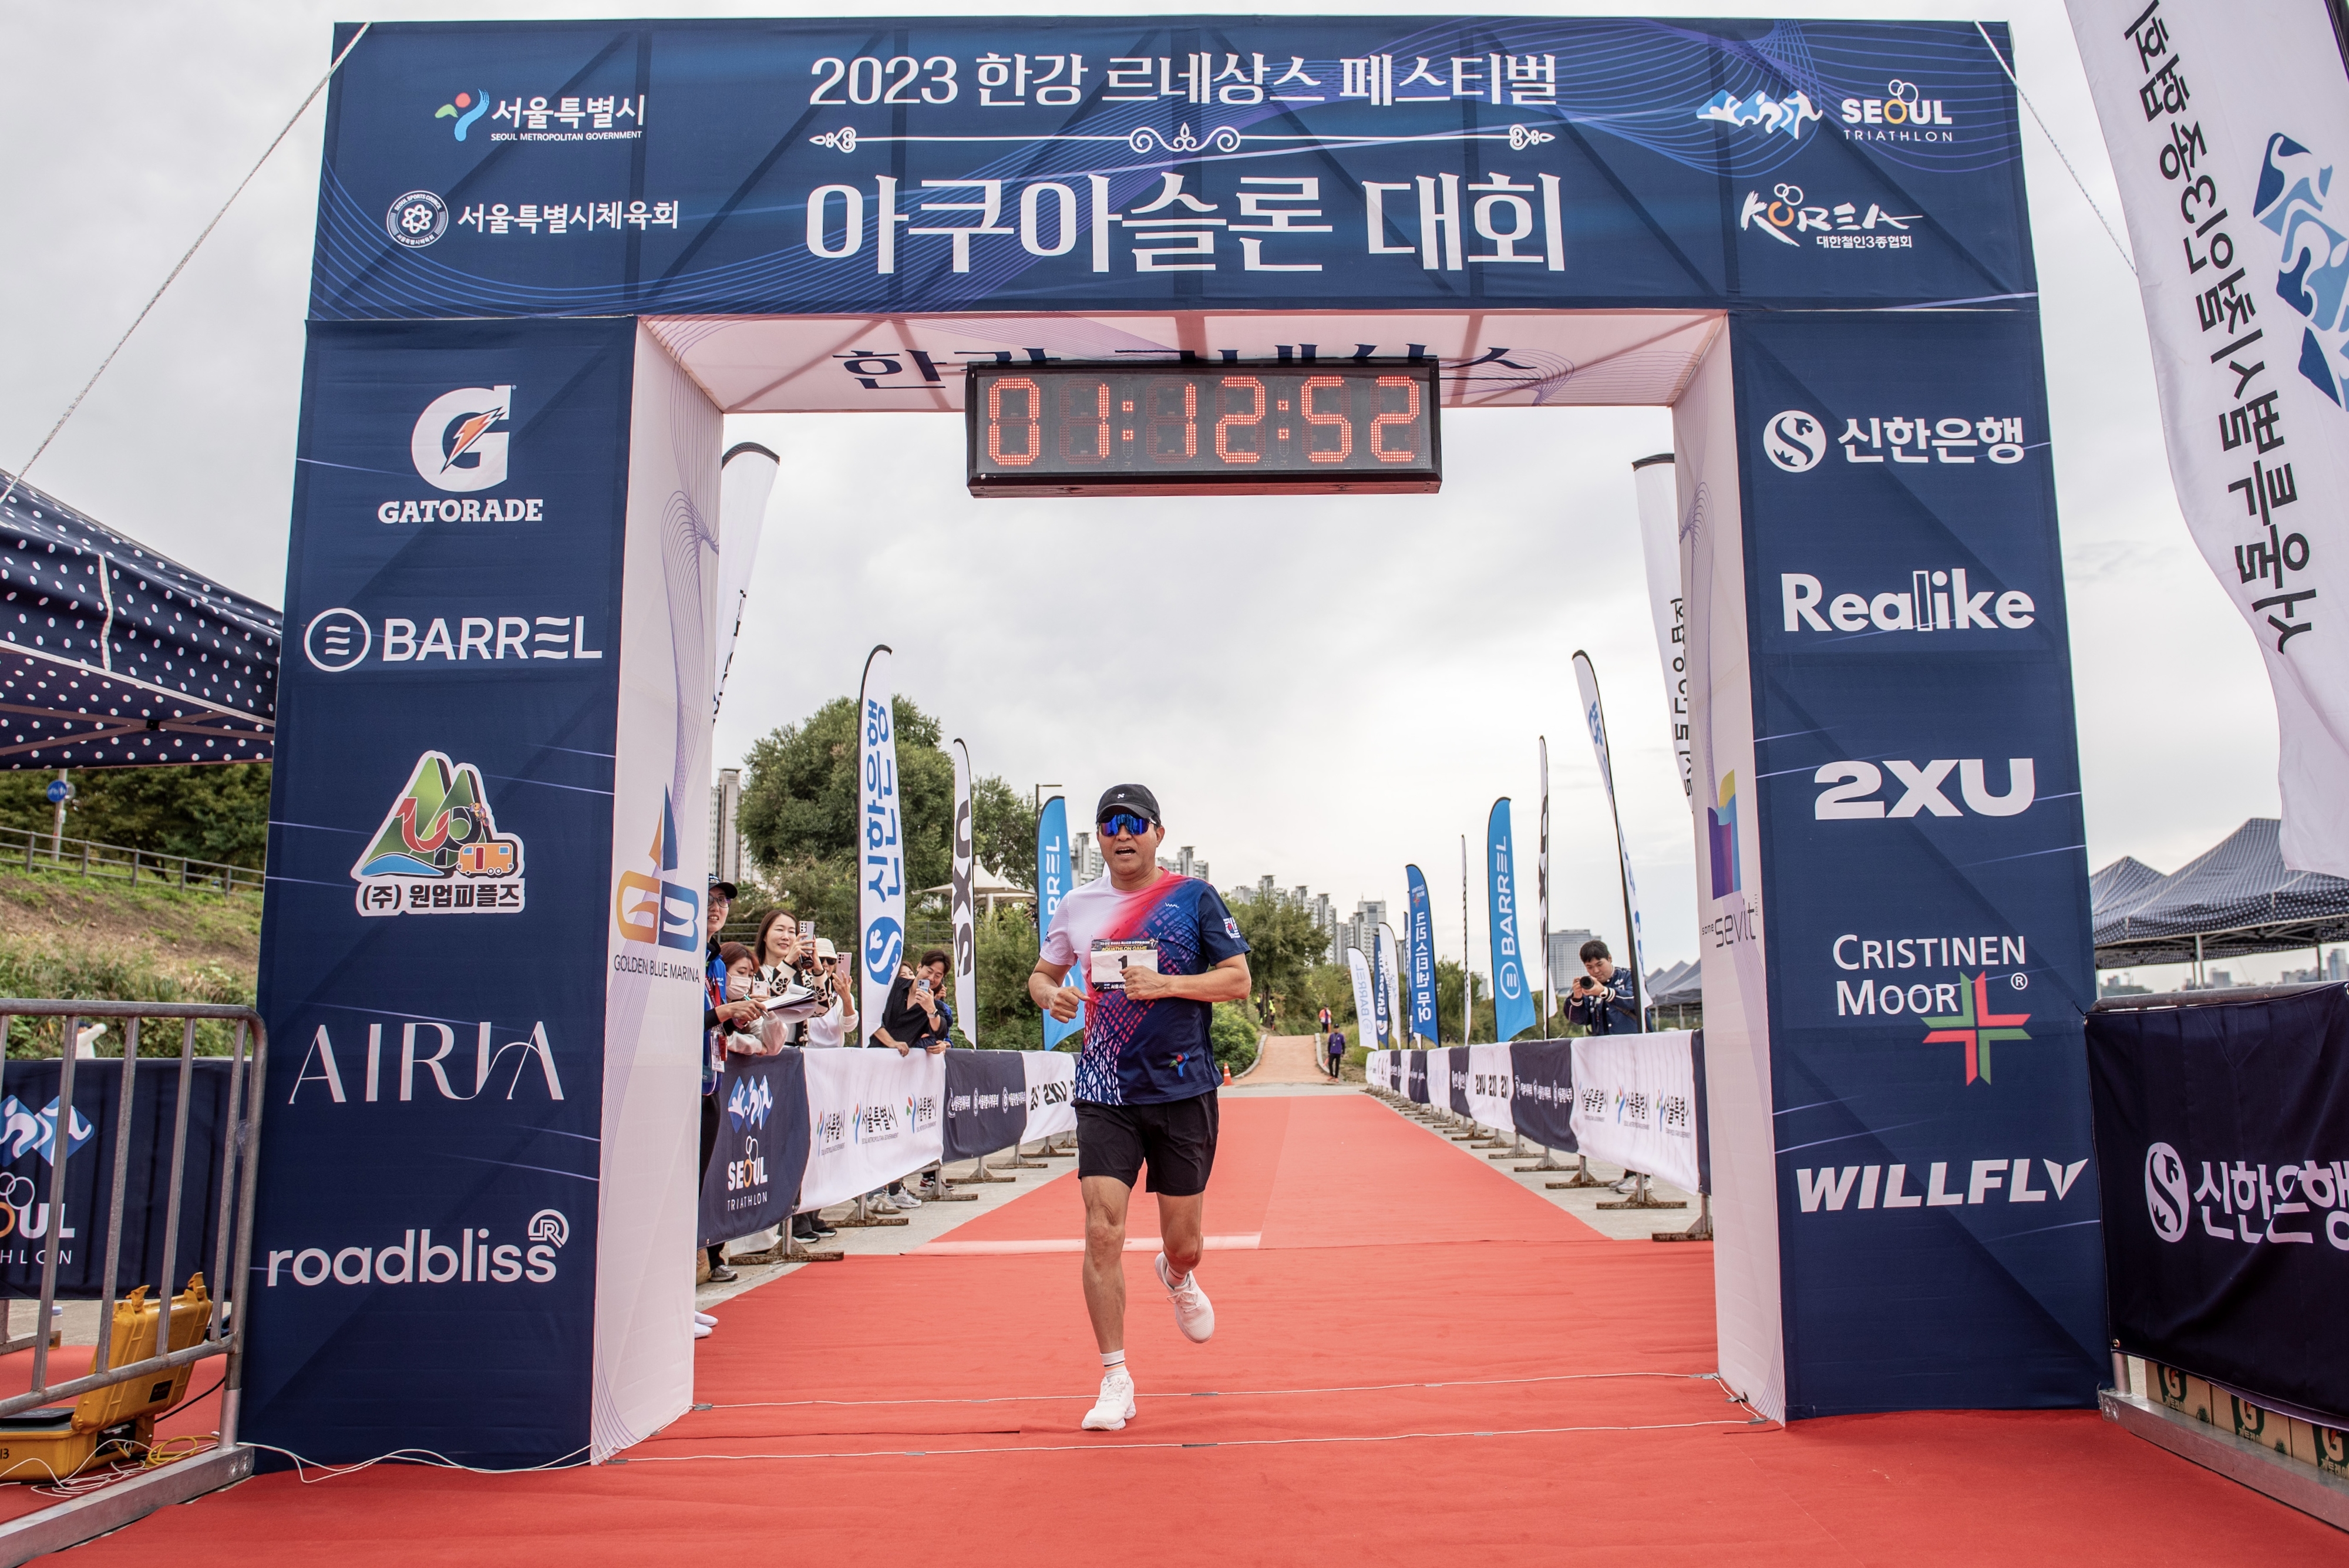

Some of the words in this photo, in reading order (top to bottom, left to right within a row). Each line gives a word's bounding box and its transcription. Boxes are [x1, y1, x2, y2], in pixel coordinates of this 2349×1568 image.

[809, 55, 958, 105] 2023
[976, 52, 1089, 106] 한강
[1102, 51, 1325, 105] 르네상스
[1339, 52, 1557, 106] 페스티벌
[492, 95, 645, 129] 서울특별시
[1840, 98, 1952, 125] SEOUL
[520, 133, 584, 142] METROPOLITAN
[585, 131, 642, 140] GOVERNMENT
[1843, 129, 1953, 142] TRIATHLON
[457, 200, 679, 234] 서울특별시체육회
[806, 171, 1333, 274] 아쿠아슬론
[1361, 171, 1565, 272] 대회
[1740, 190, 1923, 247] KOREA
[1816, 235, 1912, 249] 대한철인3종협회
[1838, 416, 2024, 464] 신한은행
[378, 499, 543, 523] GATORADE
[1781, 568, 2035, 632] Realike
[383, 615, 603, 661] BARREL
[867, 698, 901, 904] 신한은행
[1814, 758, 2035, 820] 2XU
[363, 884, 402, 910] (주)
[409, 884, 520, 908] 원업피플즈
[1496, 836, 1516, 956] BARREL
[1702, 923, 1714, 936] some
[1715, 897, 1756, 948] sevit
[614, 954, 648, 974] GOLDEN
[649, 960, 668, 978] BLUE
[670, 964, 700, 983] MARINA
[1118, 955, 1128, 977] 1
[1833, 934, 2025, 970] CRISTINEN
[1836, 980, 1958, 1016] MOOR
[1044, 1081, 1066, 1105] 2XU
[1476, 1074, 1486, 1095] 2XU
[862, 1104, 898, 1133] 서울특별시
[728, 1155, 768, 1191] SEOUL
[727, 1191, 768, 1212] TRIATHLON
[2193, 1160, 2349, 1251] 신한은행
[267, 1227, 557, 1287] roadbliss
